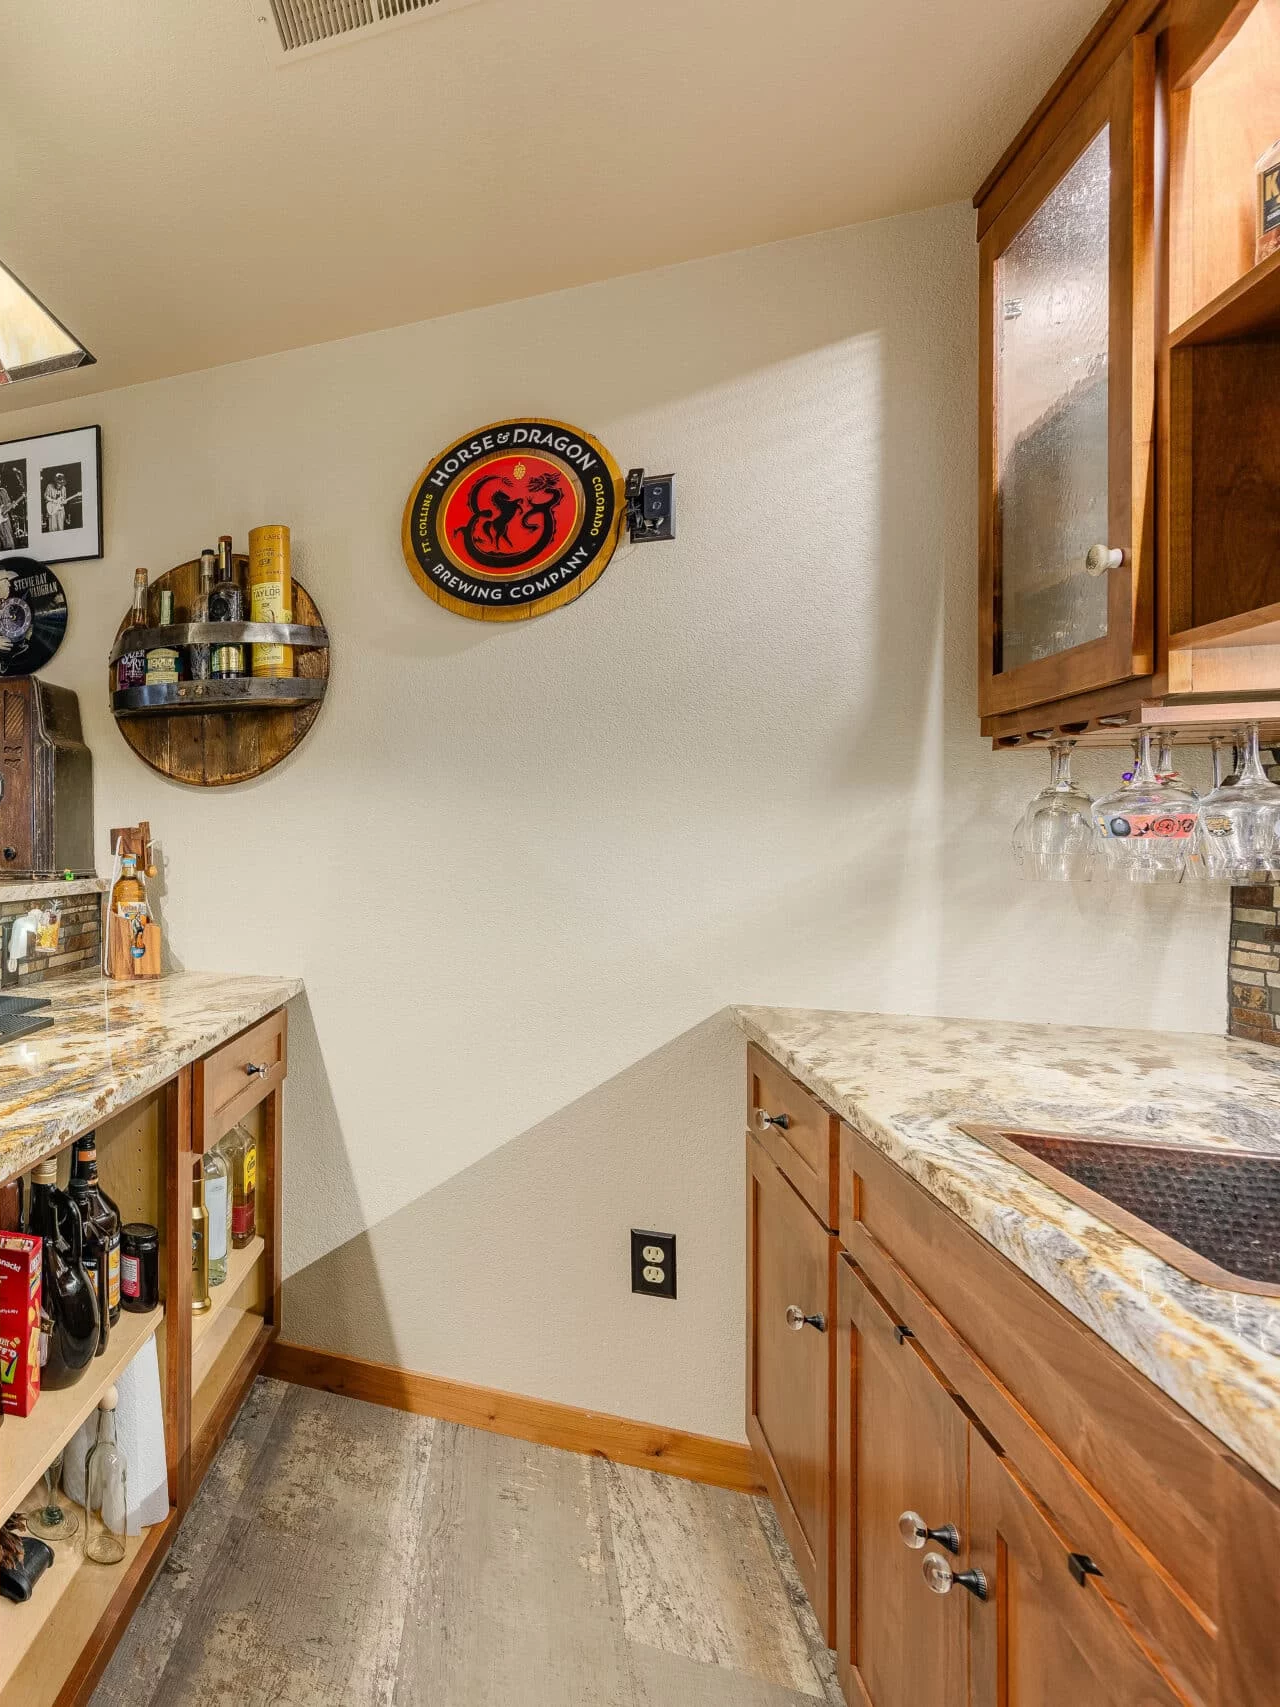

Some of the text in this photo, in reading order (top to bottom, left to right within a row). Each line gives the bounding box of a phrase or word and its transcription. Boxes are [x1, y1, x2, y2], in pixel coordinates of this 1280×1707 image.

[430, 428, 597, 487] HORSE & DRAGON
[418, 493, 434, 538] COLLINS
[590, 475, 606, 537] COLORADO
[13, 572, 47, 592] STEVIE RAY
[29, 581, 58, 598] VAUGHAN
[253, 588, 281, 599] TAYLOR
[431, 546, 589, 601] BREWING COMPANY
